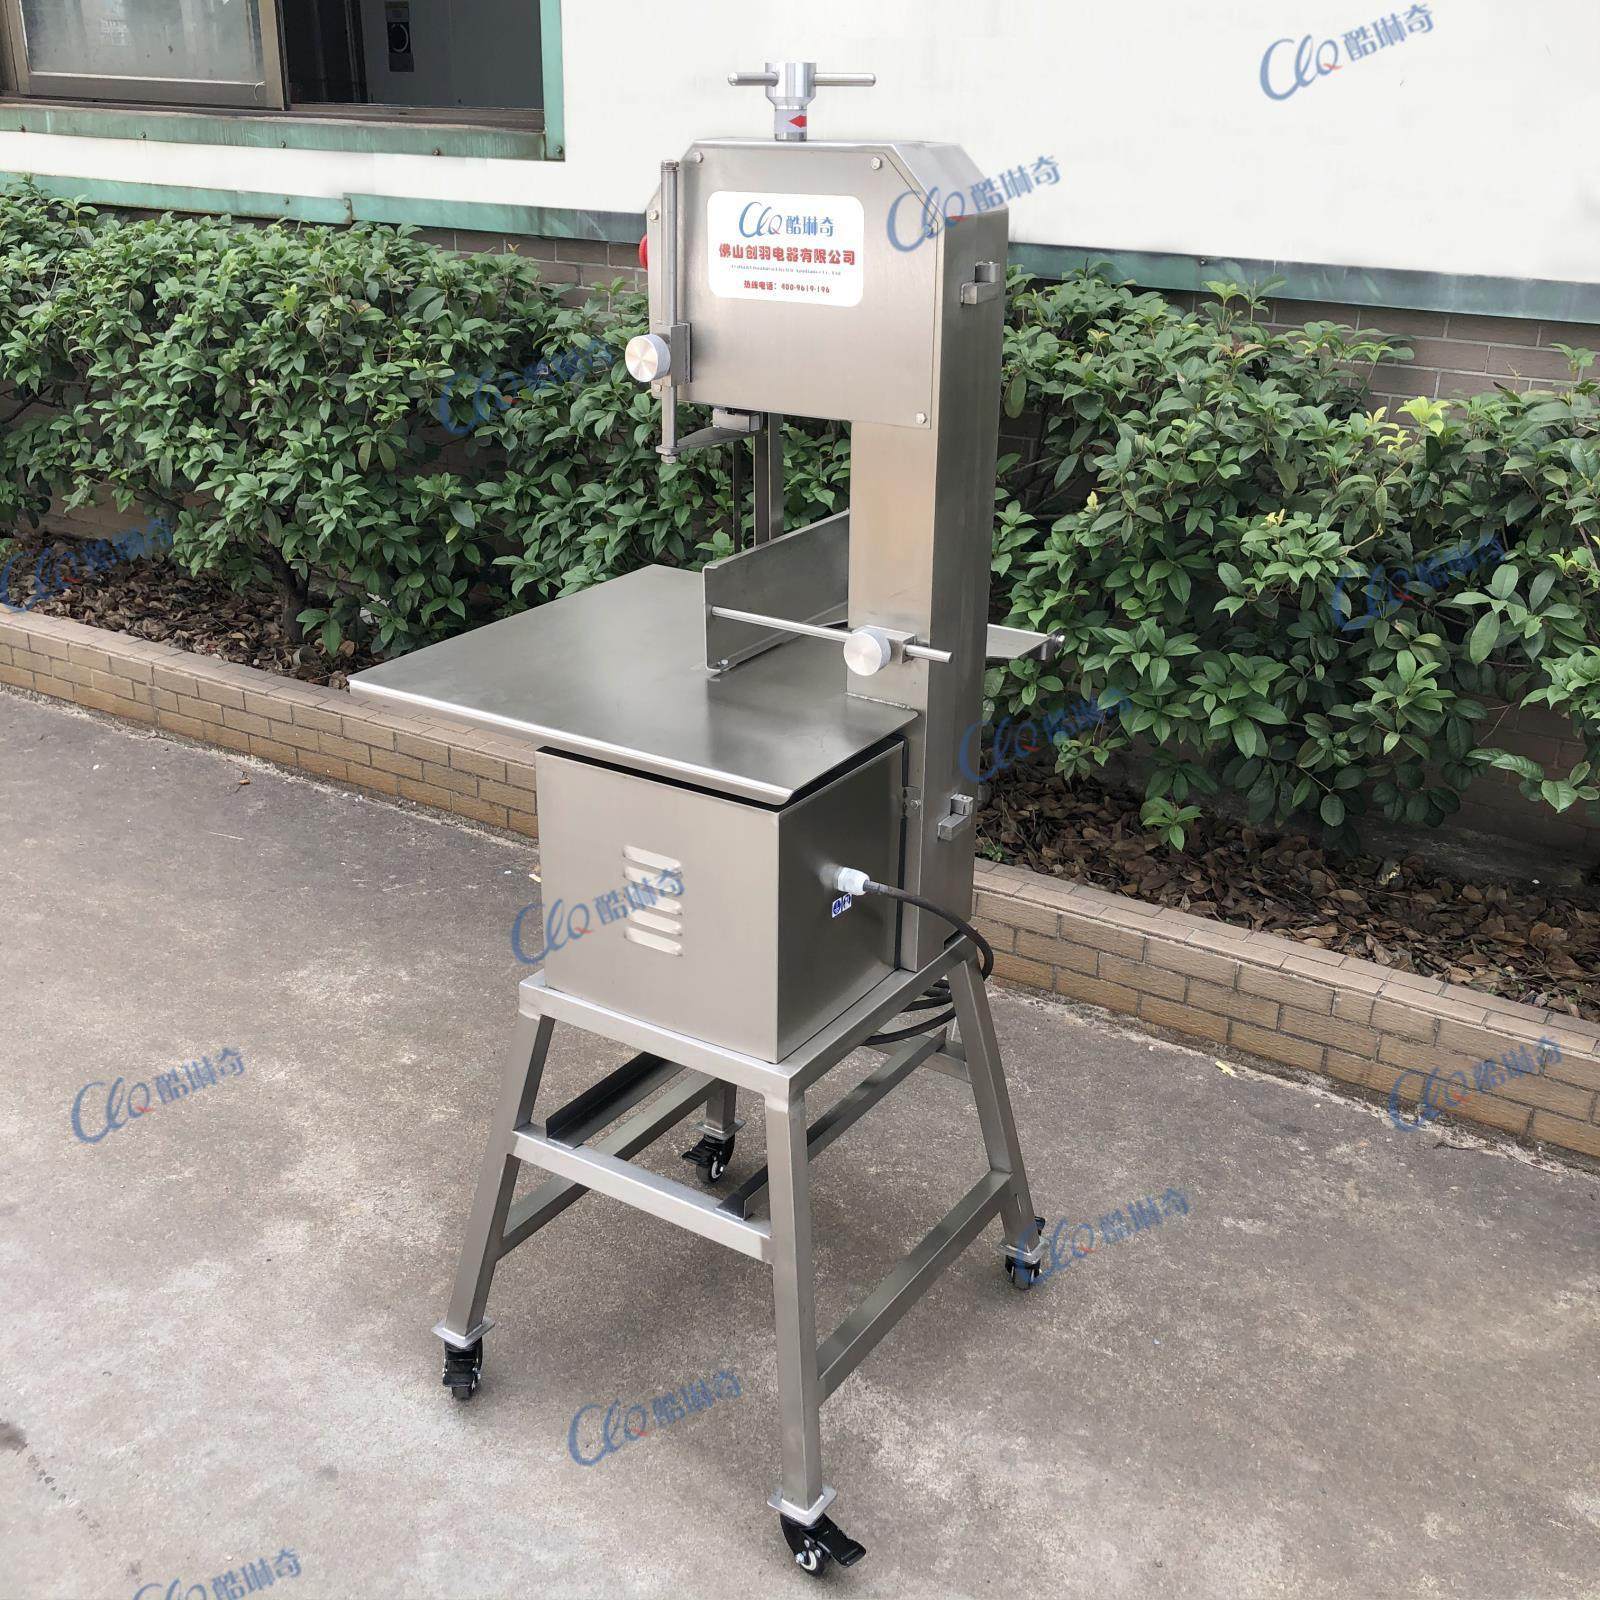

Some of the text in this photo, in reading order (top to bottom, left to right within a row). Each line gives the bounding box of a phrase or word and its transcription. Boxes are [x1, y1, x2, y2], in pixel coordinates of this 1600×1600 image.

[785, 215, 834, 237] 酷琳奇
[719, 243, 855, 265] 佛山创羽电器有限公司
